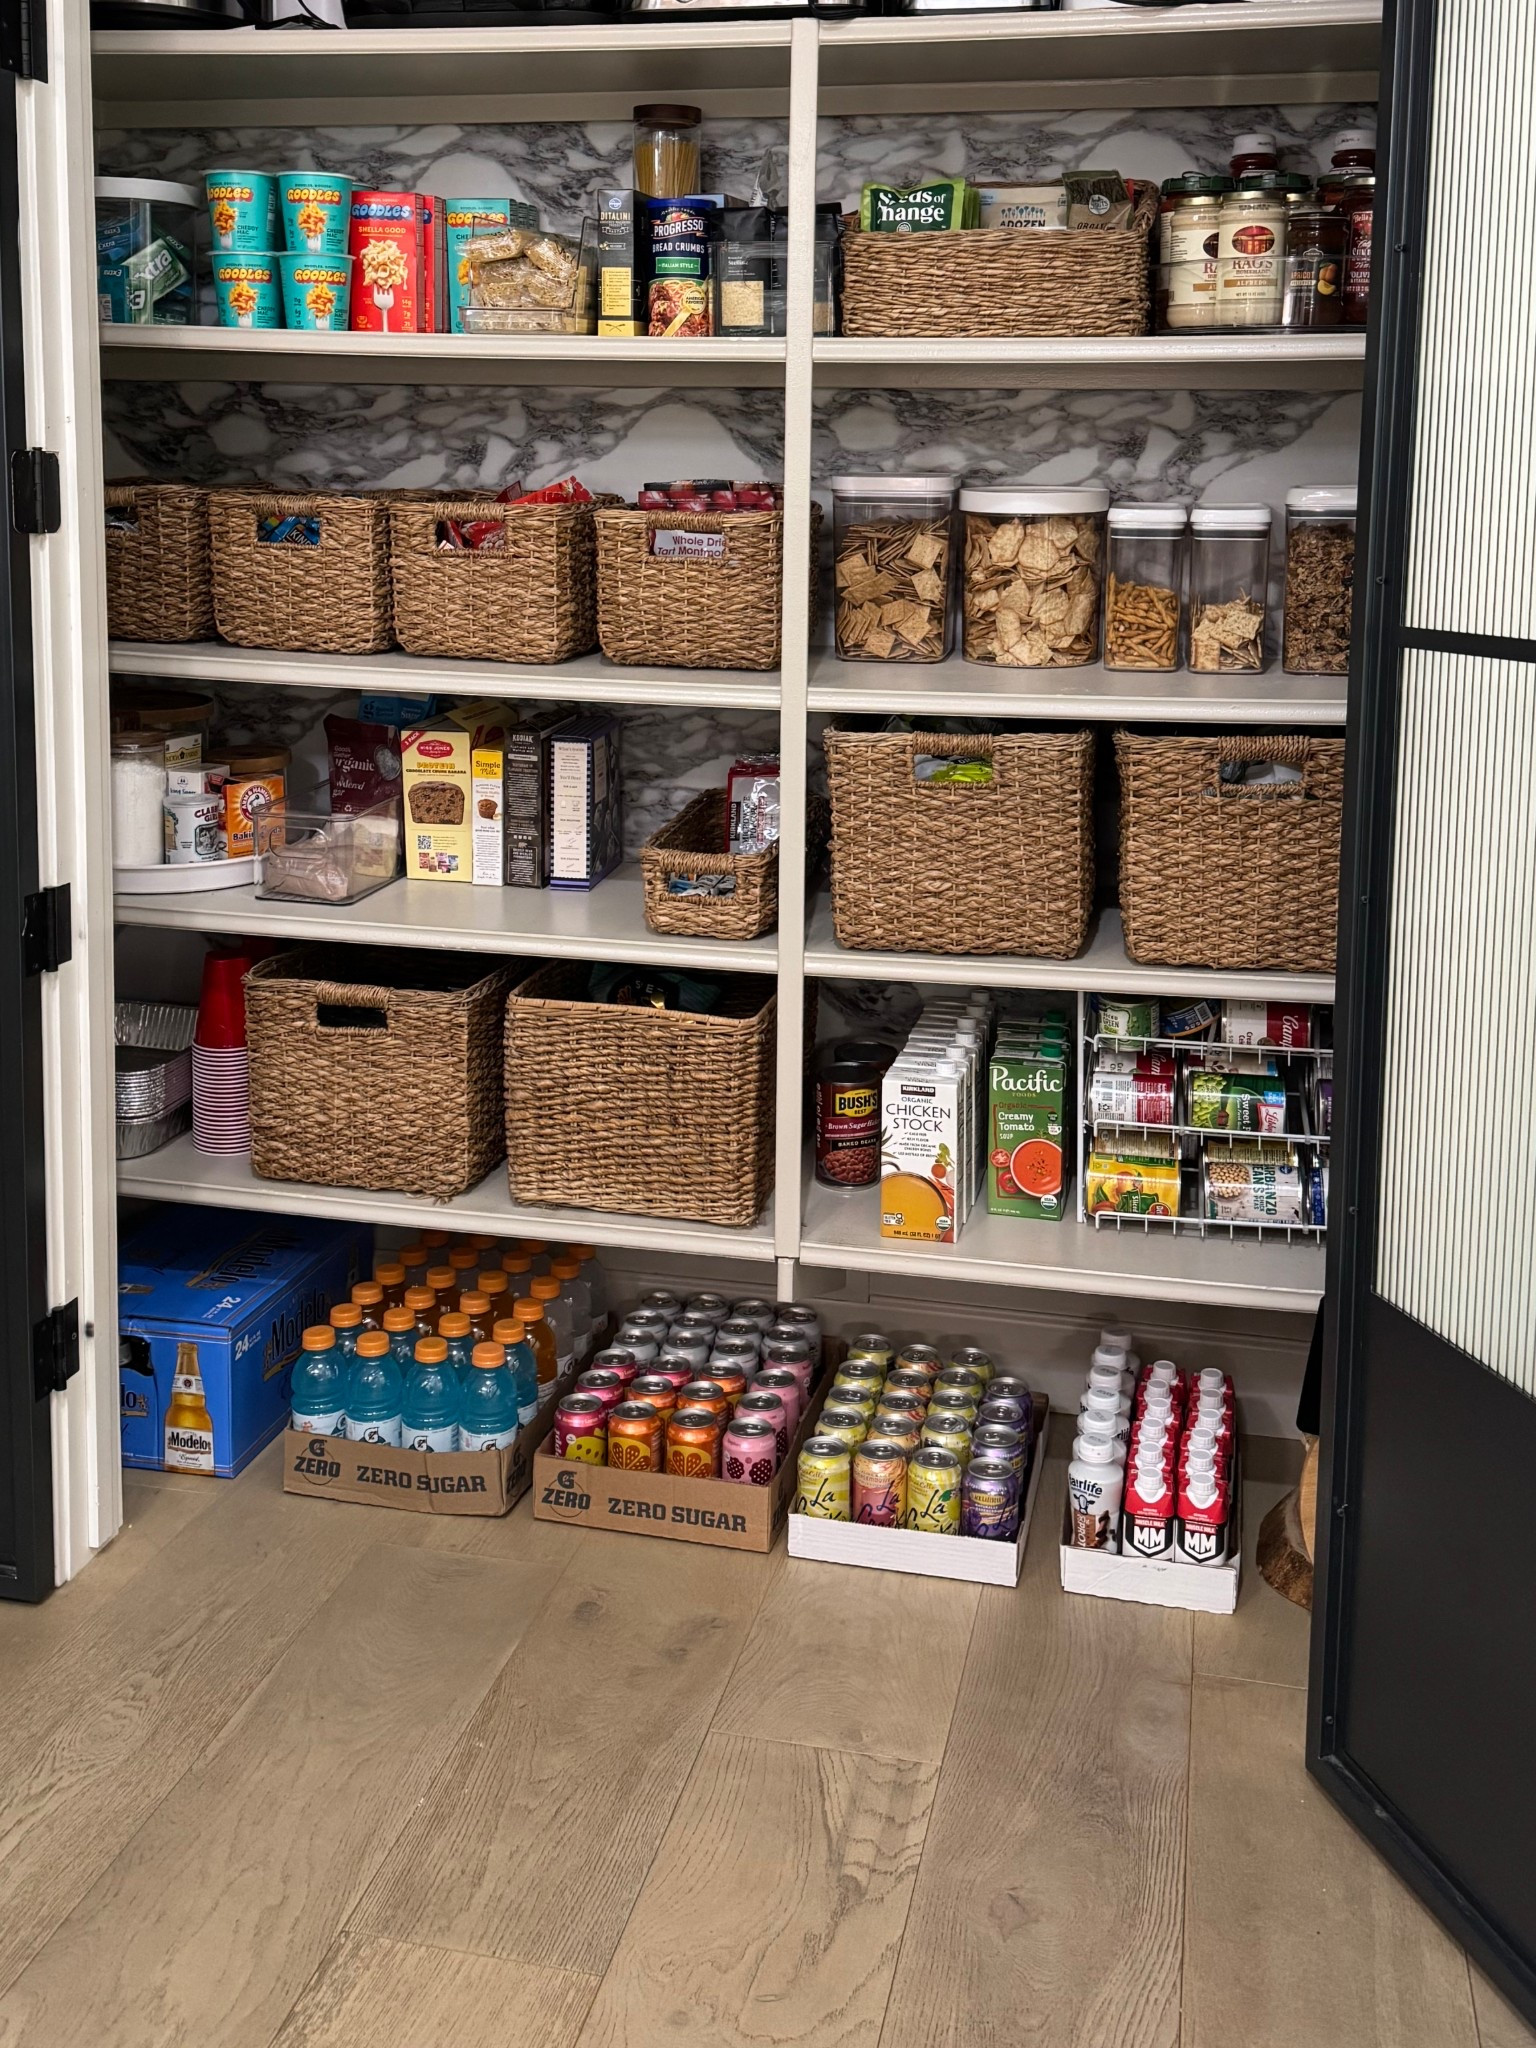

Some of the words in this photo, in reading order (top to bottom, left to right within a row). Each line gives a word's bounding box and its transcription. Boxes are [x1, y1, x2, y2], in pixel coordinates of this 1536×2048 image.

[287, 188, 341, 202] GOODLES
[933, 194, 947, 204] of
[350, 203, 412, 219] GOODLES
[600, 212, 631, 221] DITALINI
[877, 205, 945, 224] hange
[358, 226, 384, 234] SHELLA
[653, 220, 704, 238] PROGRESSO
[652, 242, 673, 254] BREAD
[675, 243, 705, 254] CRUMBS
[218, 268, 271, 280] GOODLES
[294, 269, 347, 282] GOODLES
[672, 535, 704, 546] Whole
[706, 537, 727, 547] Drie
[657, 547, 676, 556] Tart
[678, 546, 725, 557] Montmo
[512, 734, 534, 743] KODIAK
[475, 760, 501, 770] Simple
[729, 803, 737, 839] KIRKLAND
[989, 1065, 1064, 1093] Pacific
[902, 1086, 935, 1094] KIRKLAND
[838, 1091, 878, 1111] BUSH'S
[886, 1103, 951, 1119] CHICKEN
[998, 1111, 1034, 1125] Creamy
[828, 1122, 848, 1131] Brown
[848, 1121, 867, 1131] Sugar
[892, 1118, 944, 1133] STOCK
[999, 1122, 1035, 1132] Tomato
[1253, 1164, 1264, 1194] EANS
[1264, 1164, 1278, 1216] ARBANZO
[235, 1334, 250, 1361] 24
[170, 1431, 208, 1451] Modelo
[293, 1456, 341, 1478] ZERO
[356, 1465, 412, 1489] ZERO
[416, 1474, 487, 1495] SUGAR
[541, 1487, 591, 1511] ZERO
[809, 1477, 837, 1511] La
[876, 1479, 902, 1514] La
[920, 1489, 948, 1523] La
[608, 1497, 667, 1521] ZERO
[671, 1505, 747, 1533] SUGAR
[1133, 1525, 1166, 1549] MM
[1184, 1531, 1217, 1554] MM
